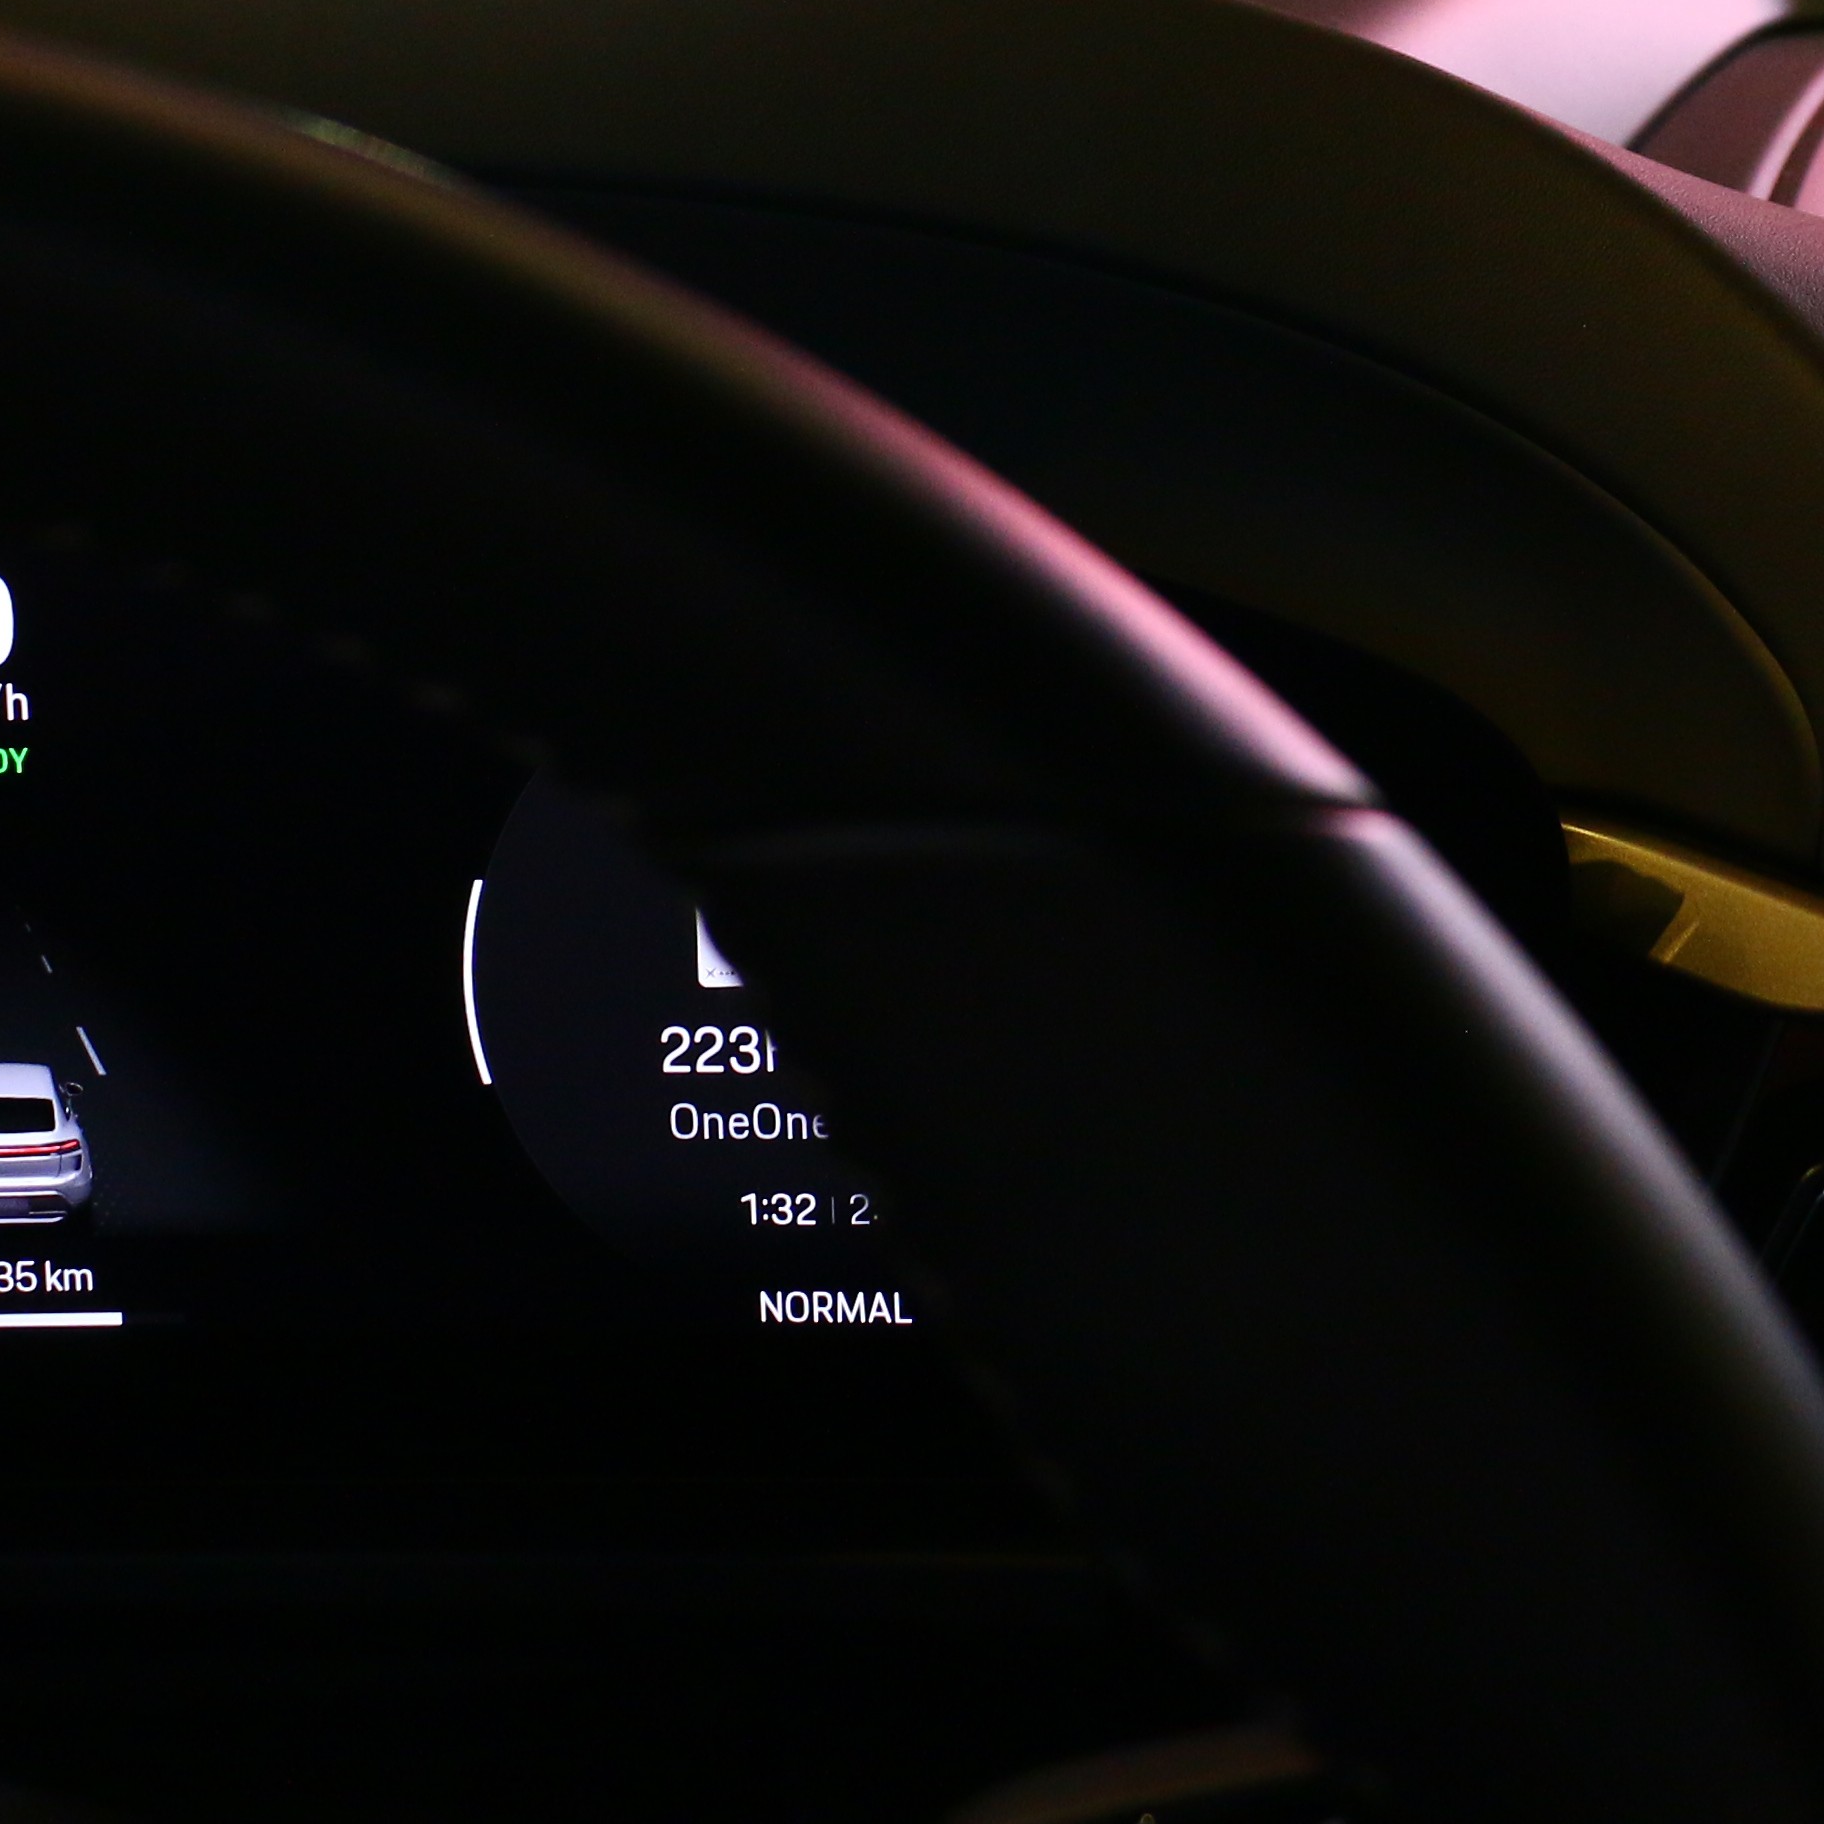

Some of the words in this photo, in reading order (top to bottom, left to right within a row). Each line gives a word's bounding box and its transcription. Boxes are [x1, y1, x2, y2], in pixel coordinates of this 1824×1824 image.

[740, 1192, 817, 1226] 1:32
[44, 1259, 94, 1293] km
[759, 1290, 913, 1324] NORMAL
